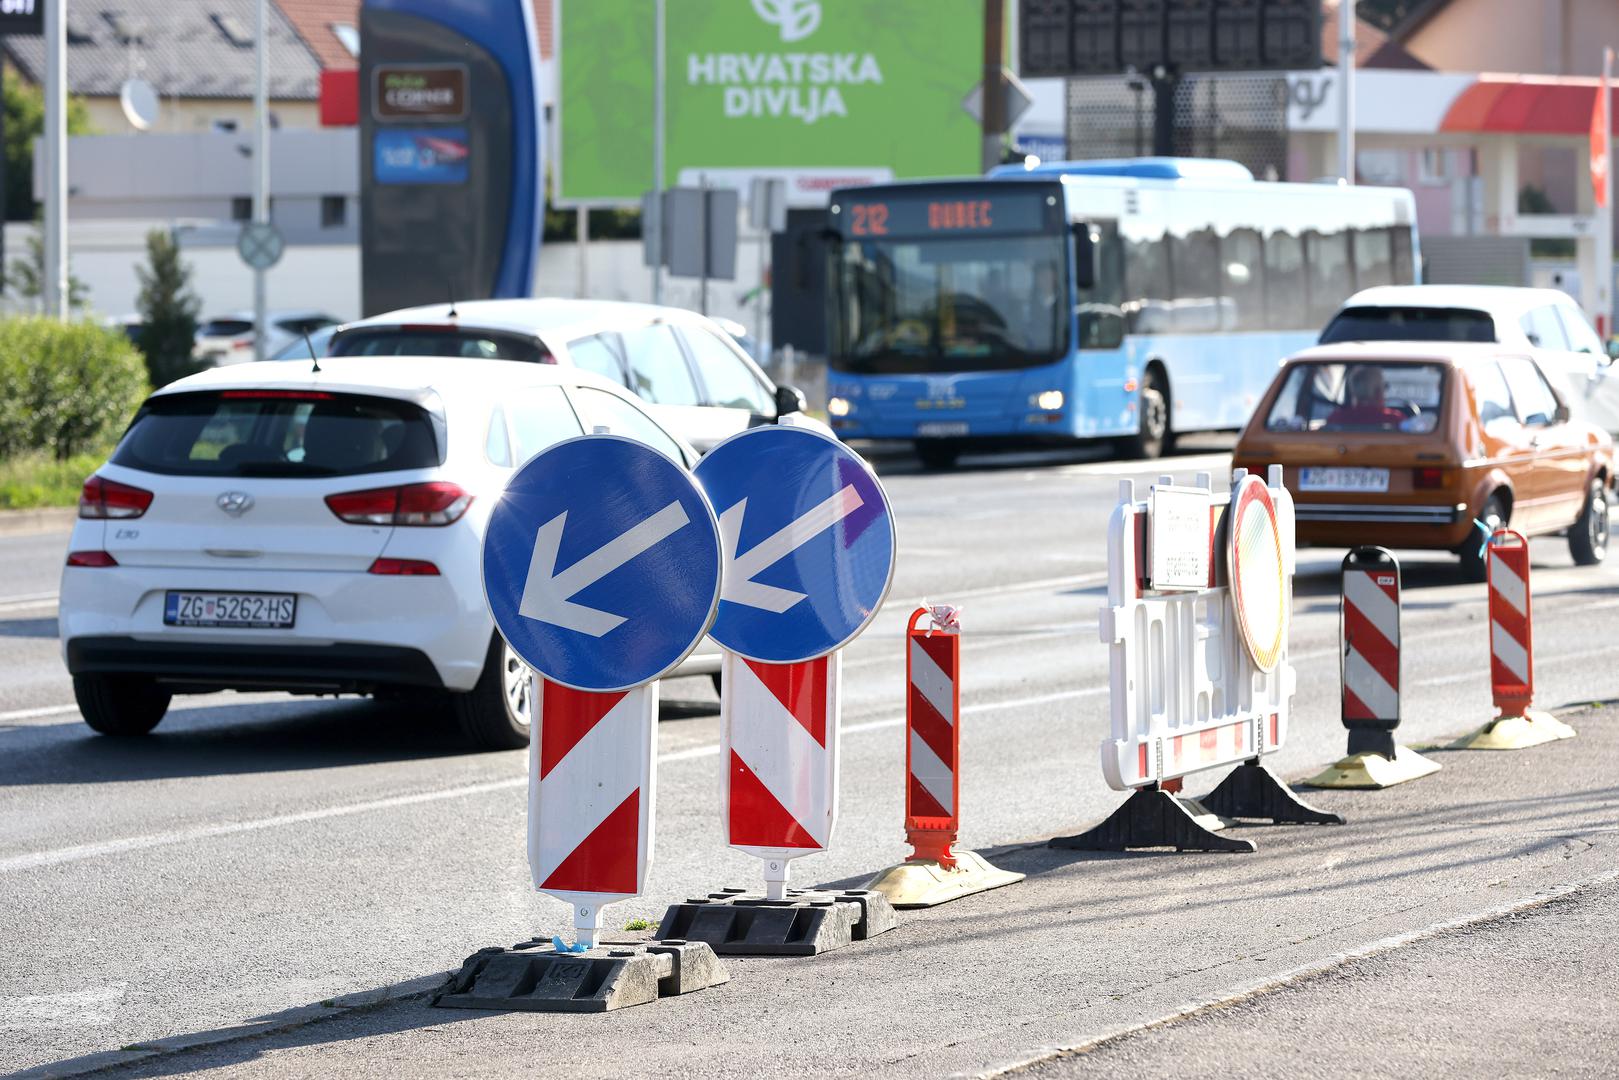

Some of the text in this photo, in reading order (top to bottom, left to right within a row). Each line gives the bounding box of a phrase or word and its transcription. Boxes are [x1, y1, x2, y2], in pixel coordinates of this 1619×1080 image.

[687, 53, 883, 85] HRVATSKA
[724, 86, 848, 124] DIVLJA
[851, 203, 889, 236] 212
[179, 596, 204, 619] ZG
